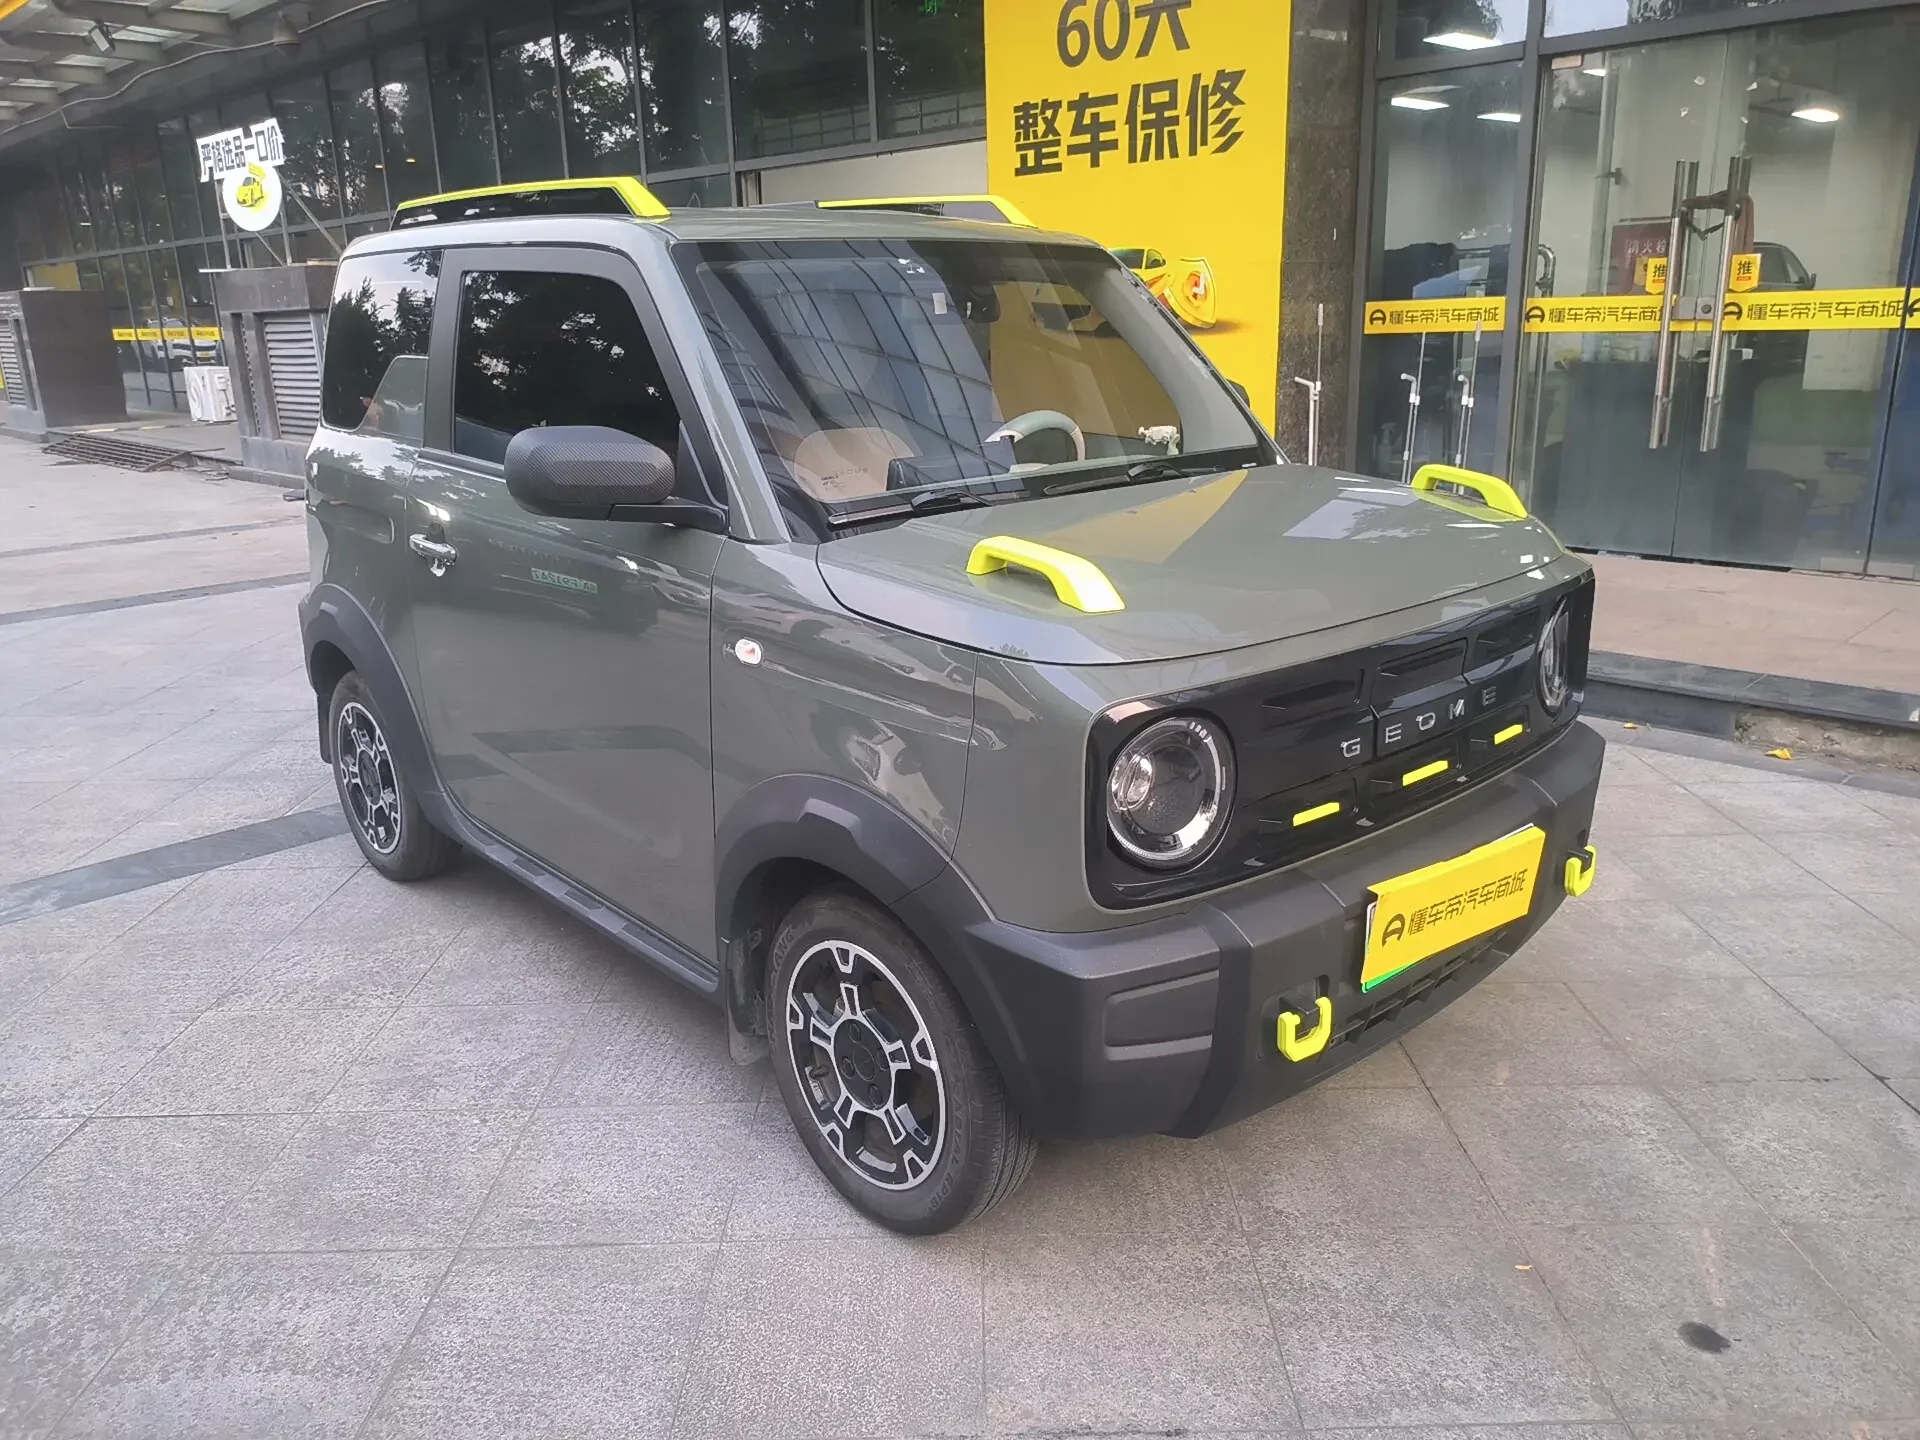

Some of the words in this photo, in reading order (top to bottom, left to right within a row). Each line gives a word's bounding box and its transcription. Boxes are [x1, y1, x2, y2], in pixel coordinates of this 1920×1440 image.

[1056, 0, 1192, 68] 60天
[1013, 69, 1247, 177] 整车保修
[200, 125, 281, 176] 严格选品一口价
[1652, 263, 1667, 278] 推
[1736, 260, 1753, 276] 推
[1389, 306, 1500, 325] 懂车帝汽车商城
[1746, 300, 1904, 320] 懂车帝汽车商城
[1340, 686, 1497, 758] GEOME
[1408, 868, 1529, 936] 懂车帝汽车商城
